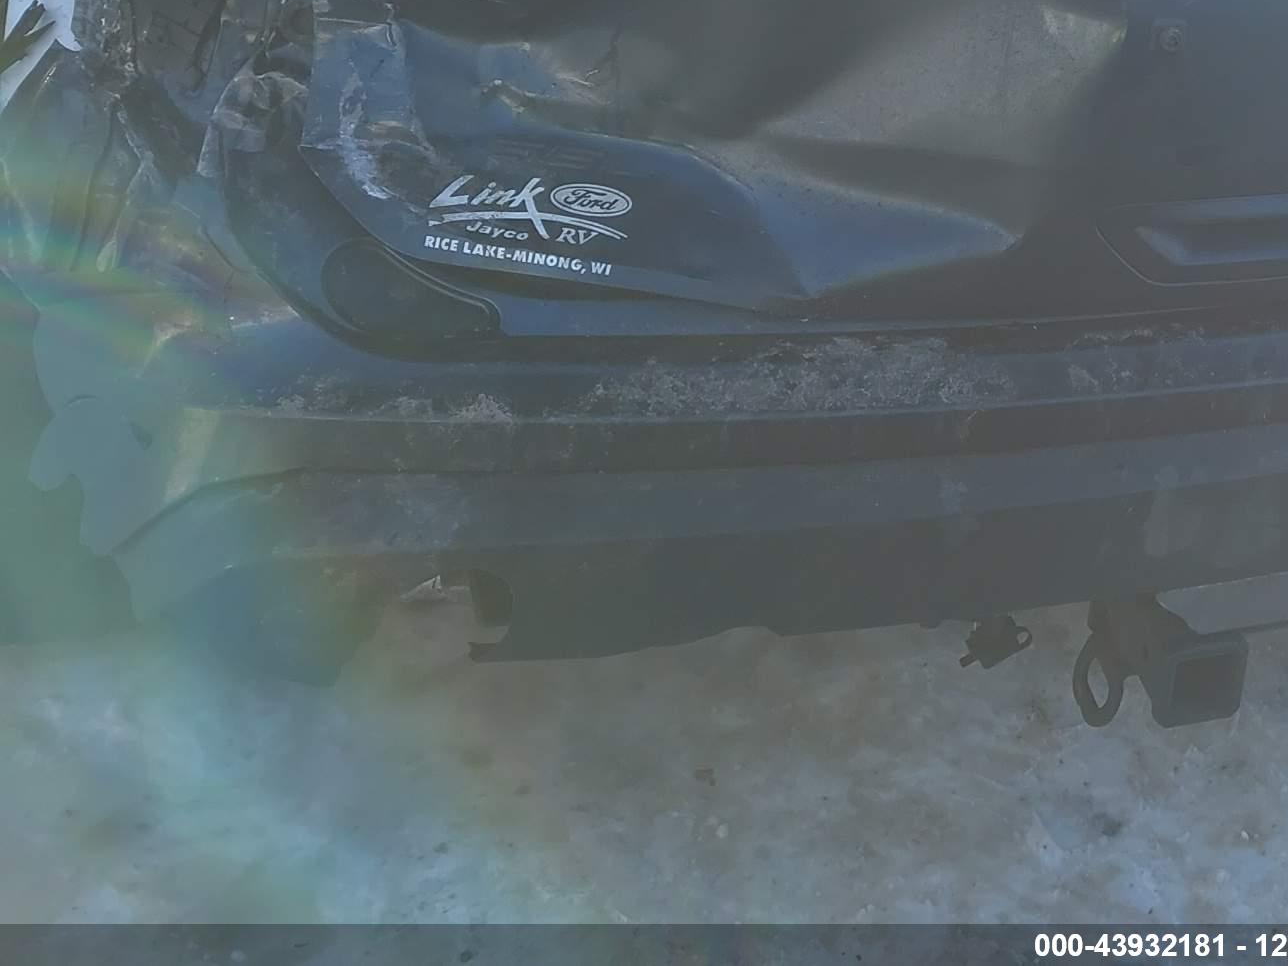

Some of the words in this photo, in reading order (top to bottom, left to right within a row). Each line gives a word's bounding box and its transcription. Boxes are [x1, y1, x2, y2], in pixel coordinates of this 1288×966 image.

[429, 175, 550, 239] Link
[565, 189, 618, 211] Ford
[466, 221, 529, 240] Jayco
[556, 227, 599, 244] RV
[424, 235, 459, 252] RICE
[463, 241, 587, 274] LAKE-MINONG,
[591, 261, 612, 276] WI
